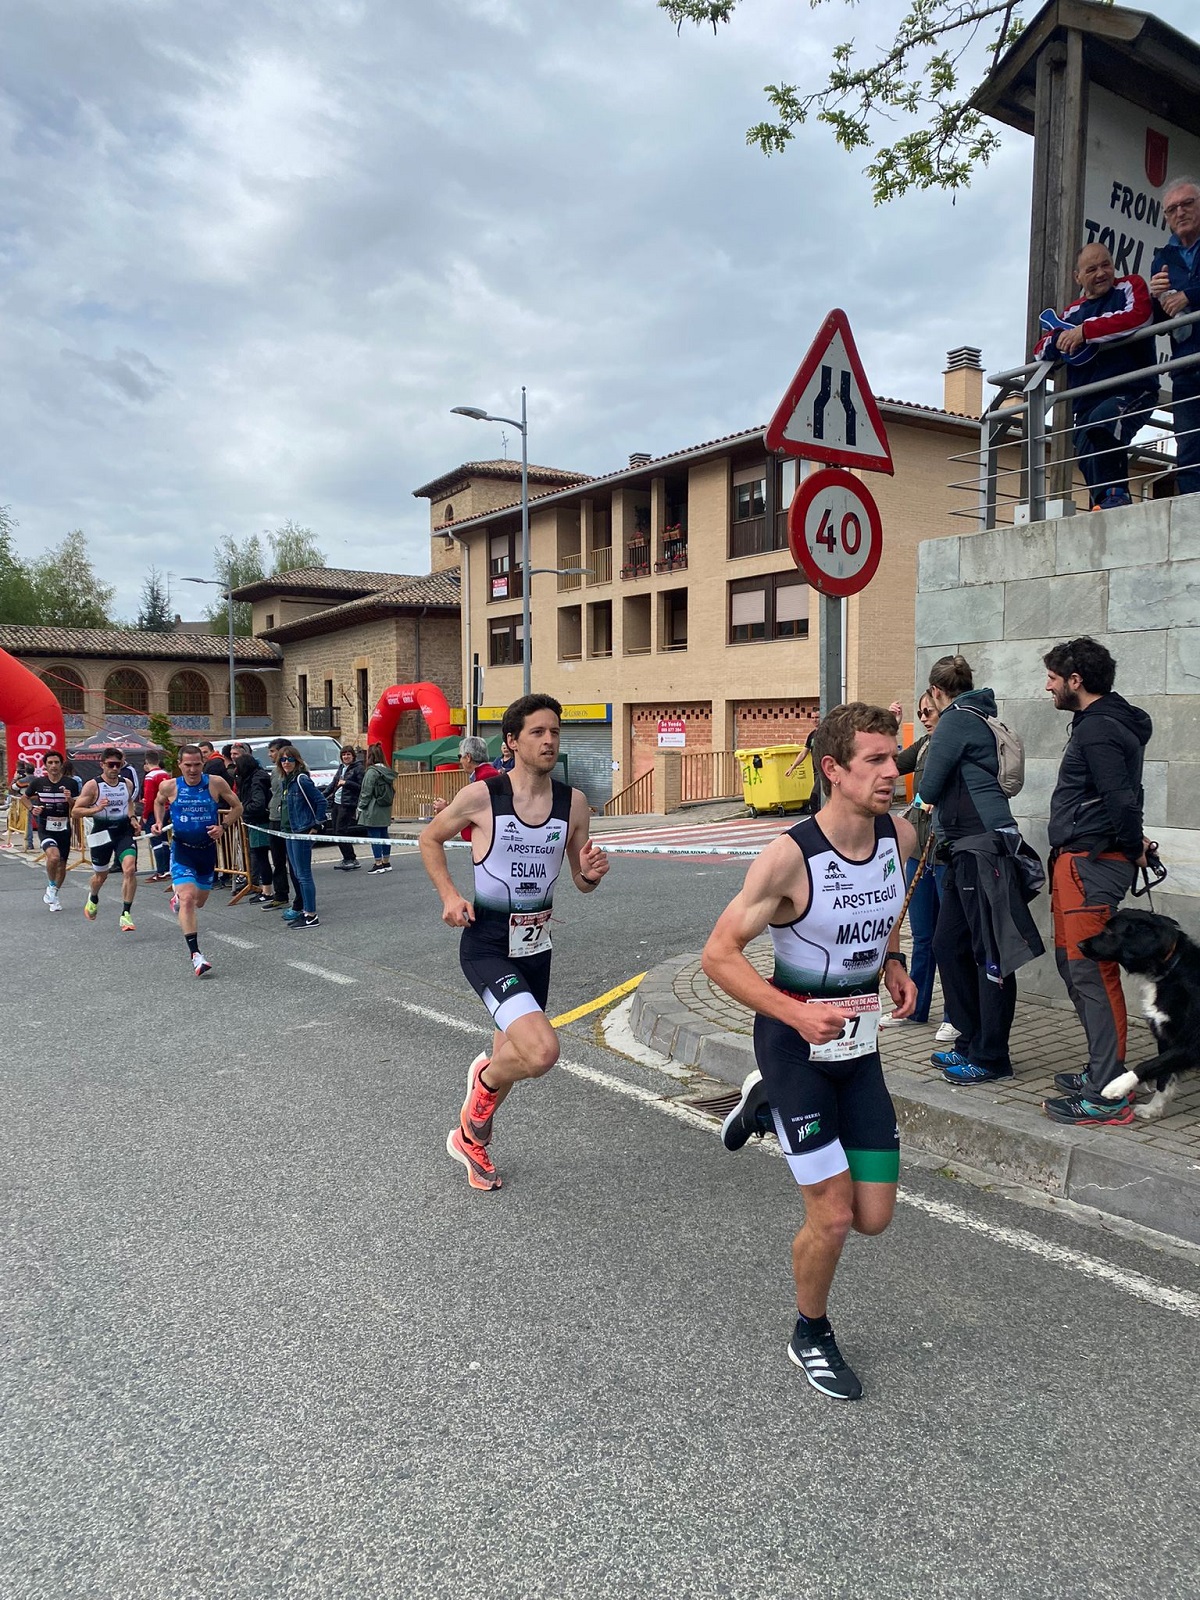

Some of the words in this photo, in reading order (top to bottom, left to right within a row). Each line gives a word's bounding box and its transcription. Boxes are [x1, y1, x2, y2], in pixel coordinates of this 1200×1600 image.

[815, 509, 862, 555] 40
[511, 862, 547, 878] ESLAVA
[522, 925, 544, 942] 27
[835, 916, 894, 945] MACIAS
